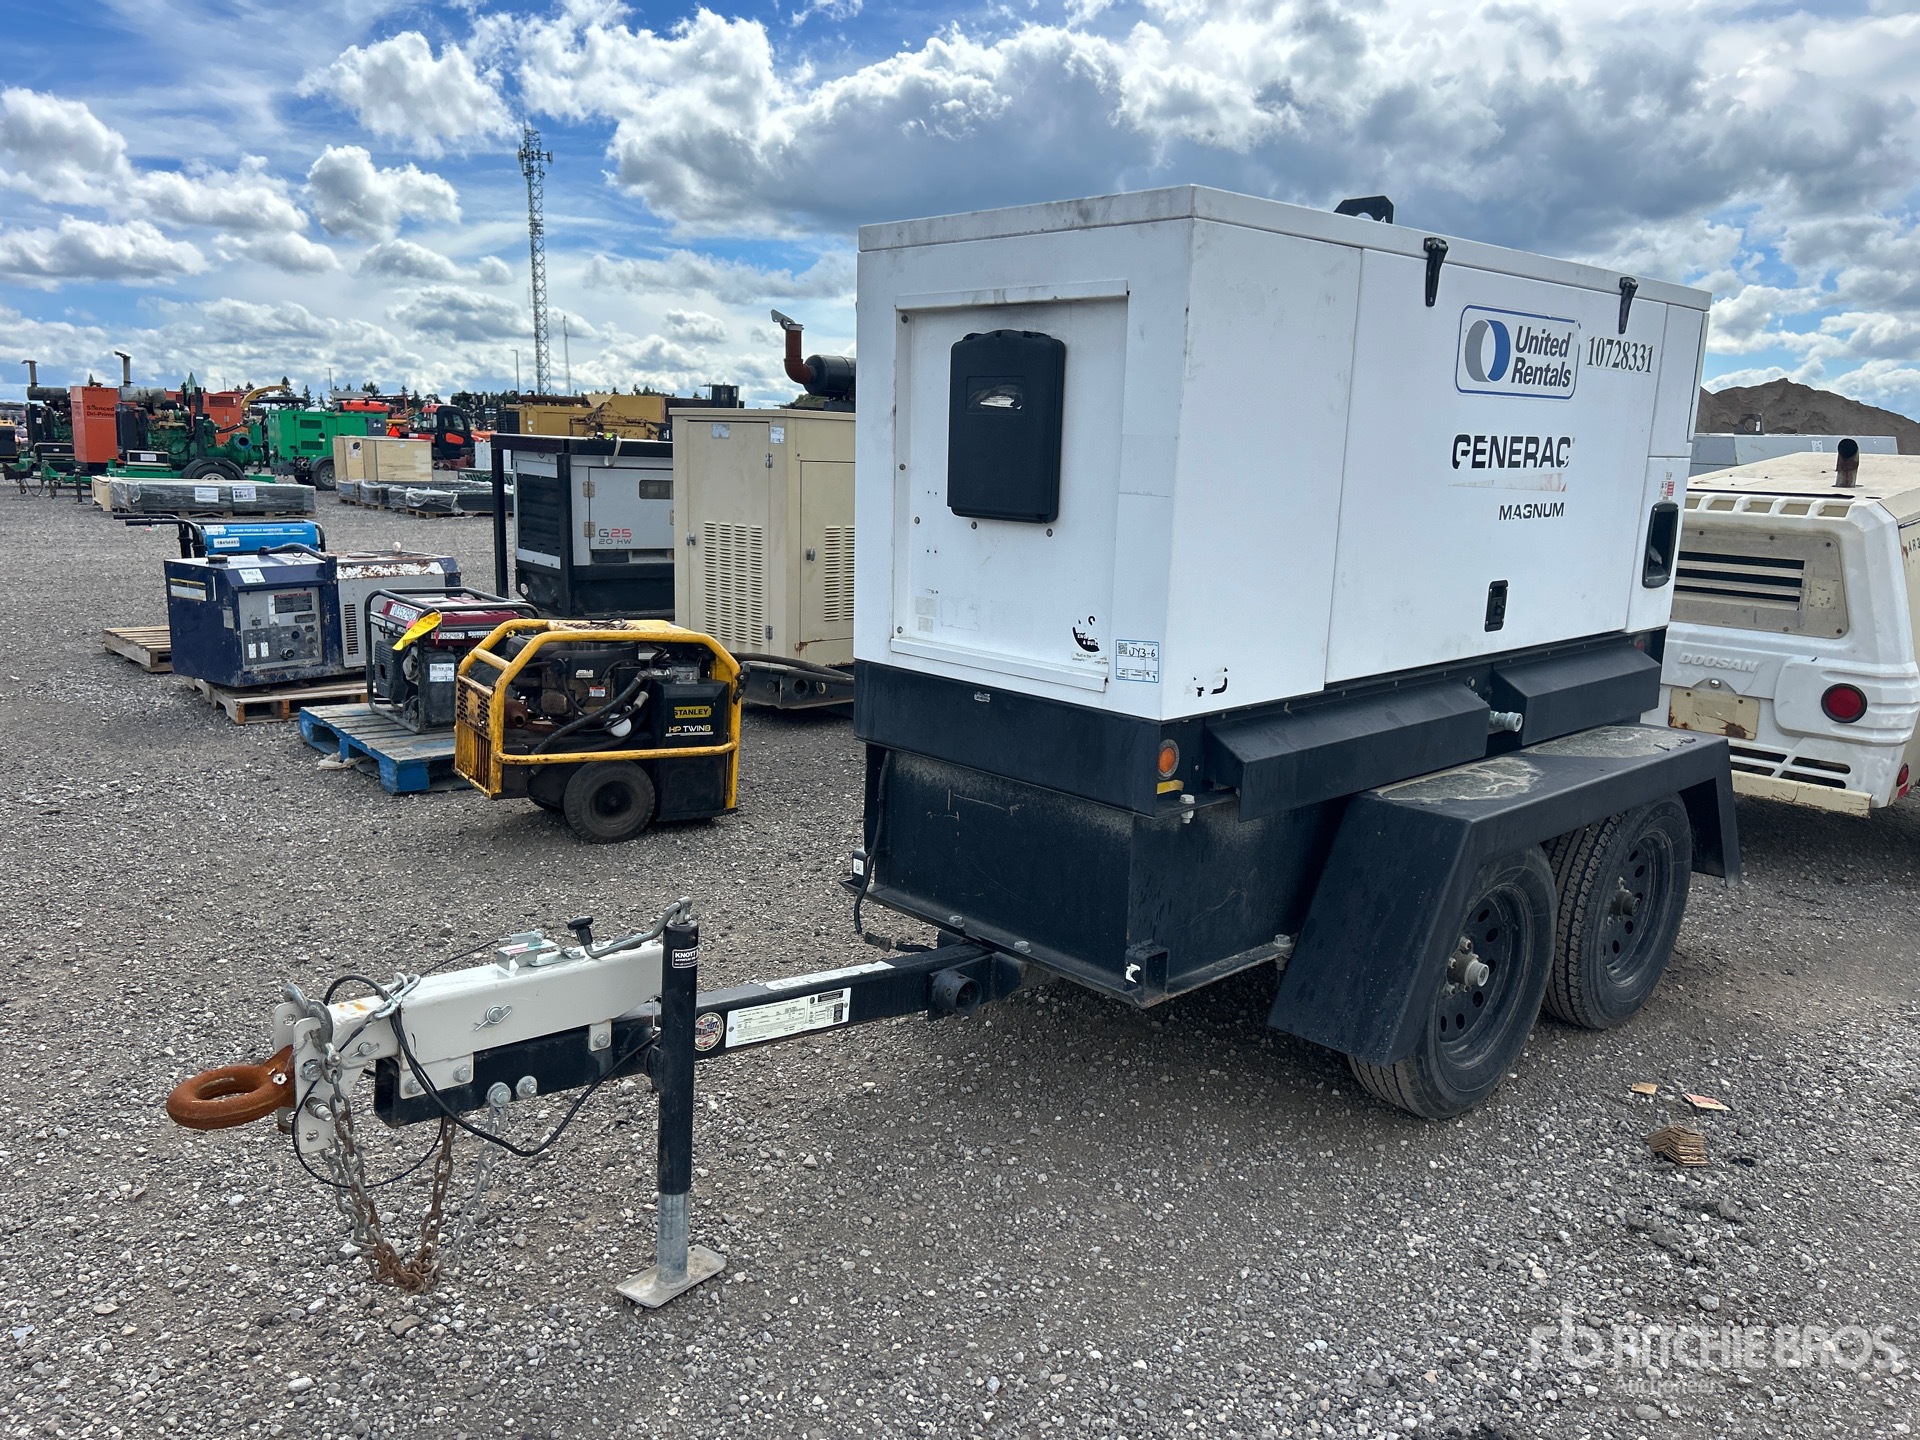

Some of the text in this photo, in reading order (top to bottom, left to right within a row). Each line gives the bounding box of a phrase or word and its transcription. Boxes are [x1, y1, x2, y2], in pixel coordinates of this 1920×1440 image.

[1515, 325, 1572, 358] United
[1587, 336, 1654, 373] 10728331
[1510, 356, 1572, 388] Rentals
[1451, 433, 1571, 470] GENERAC
[1498, 502, 1565, 521] MAGNUM
[598, 528, 632, 538] G25
[1677, 652, 1759, 673] DOOSAN
[674, 707, 709, 717] STANLEY
[668, 725, 682, 733] HP
[674, 950, 696, 958] KNOTT
